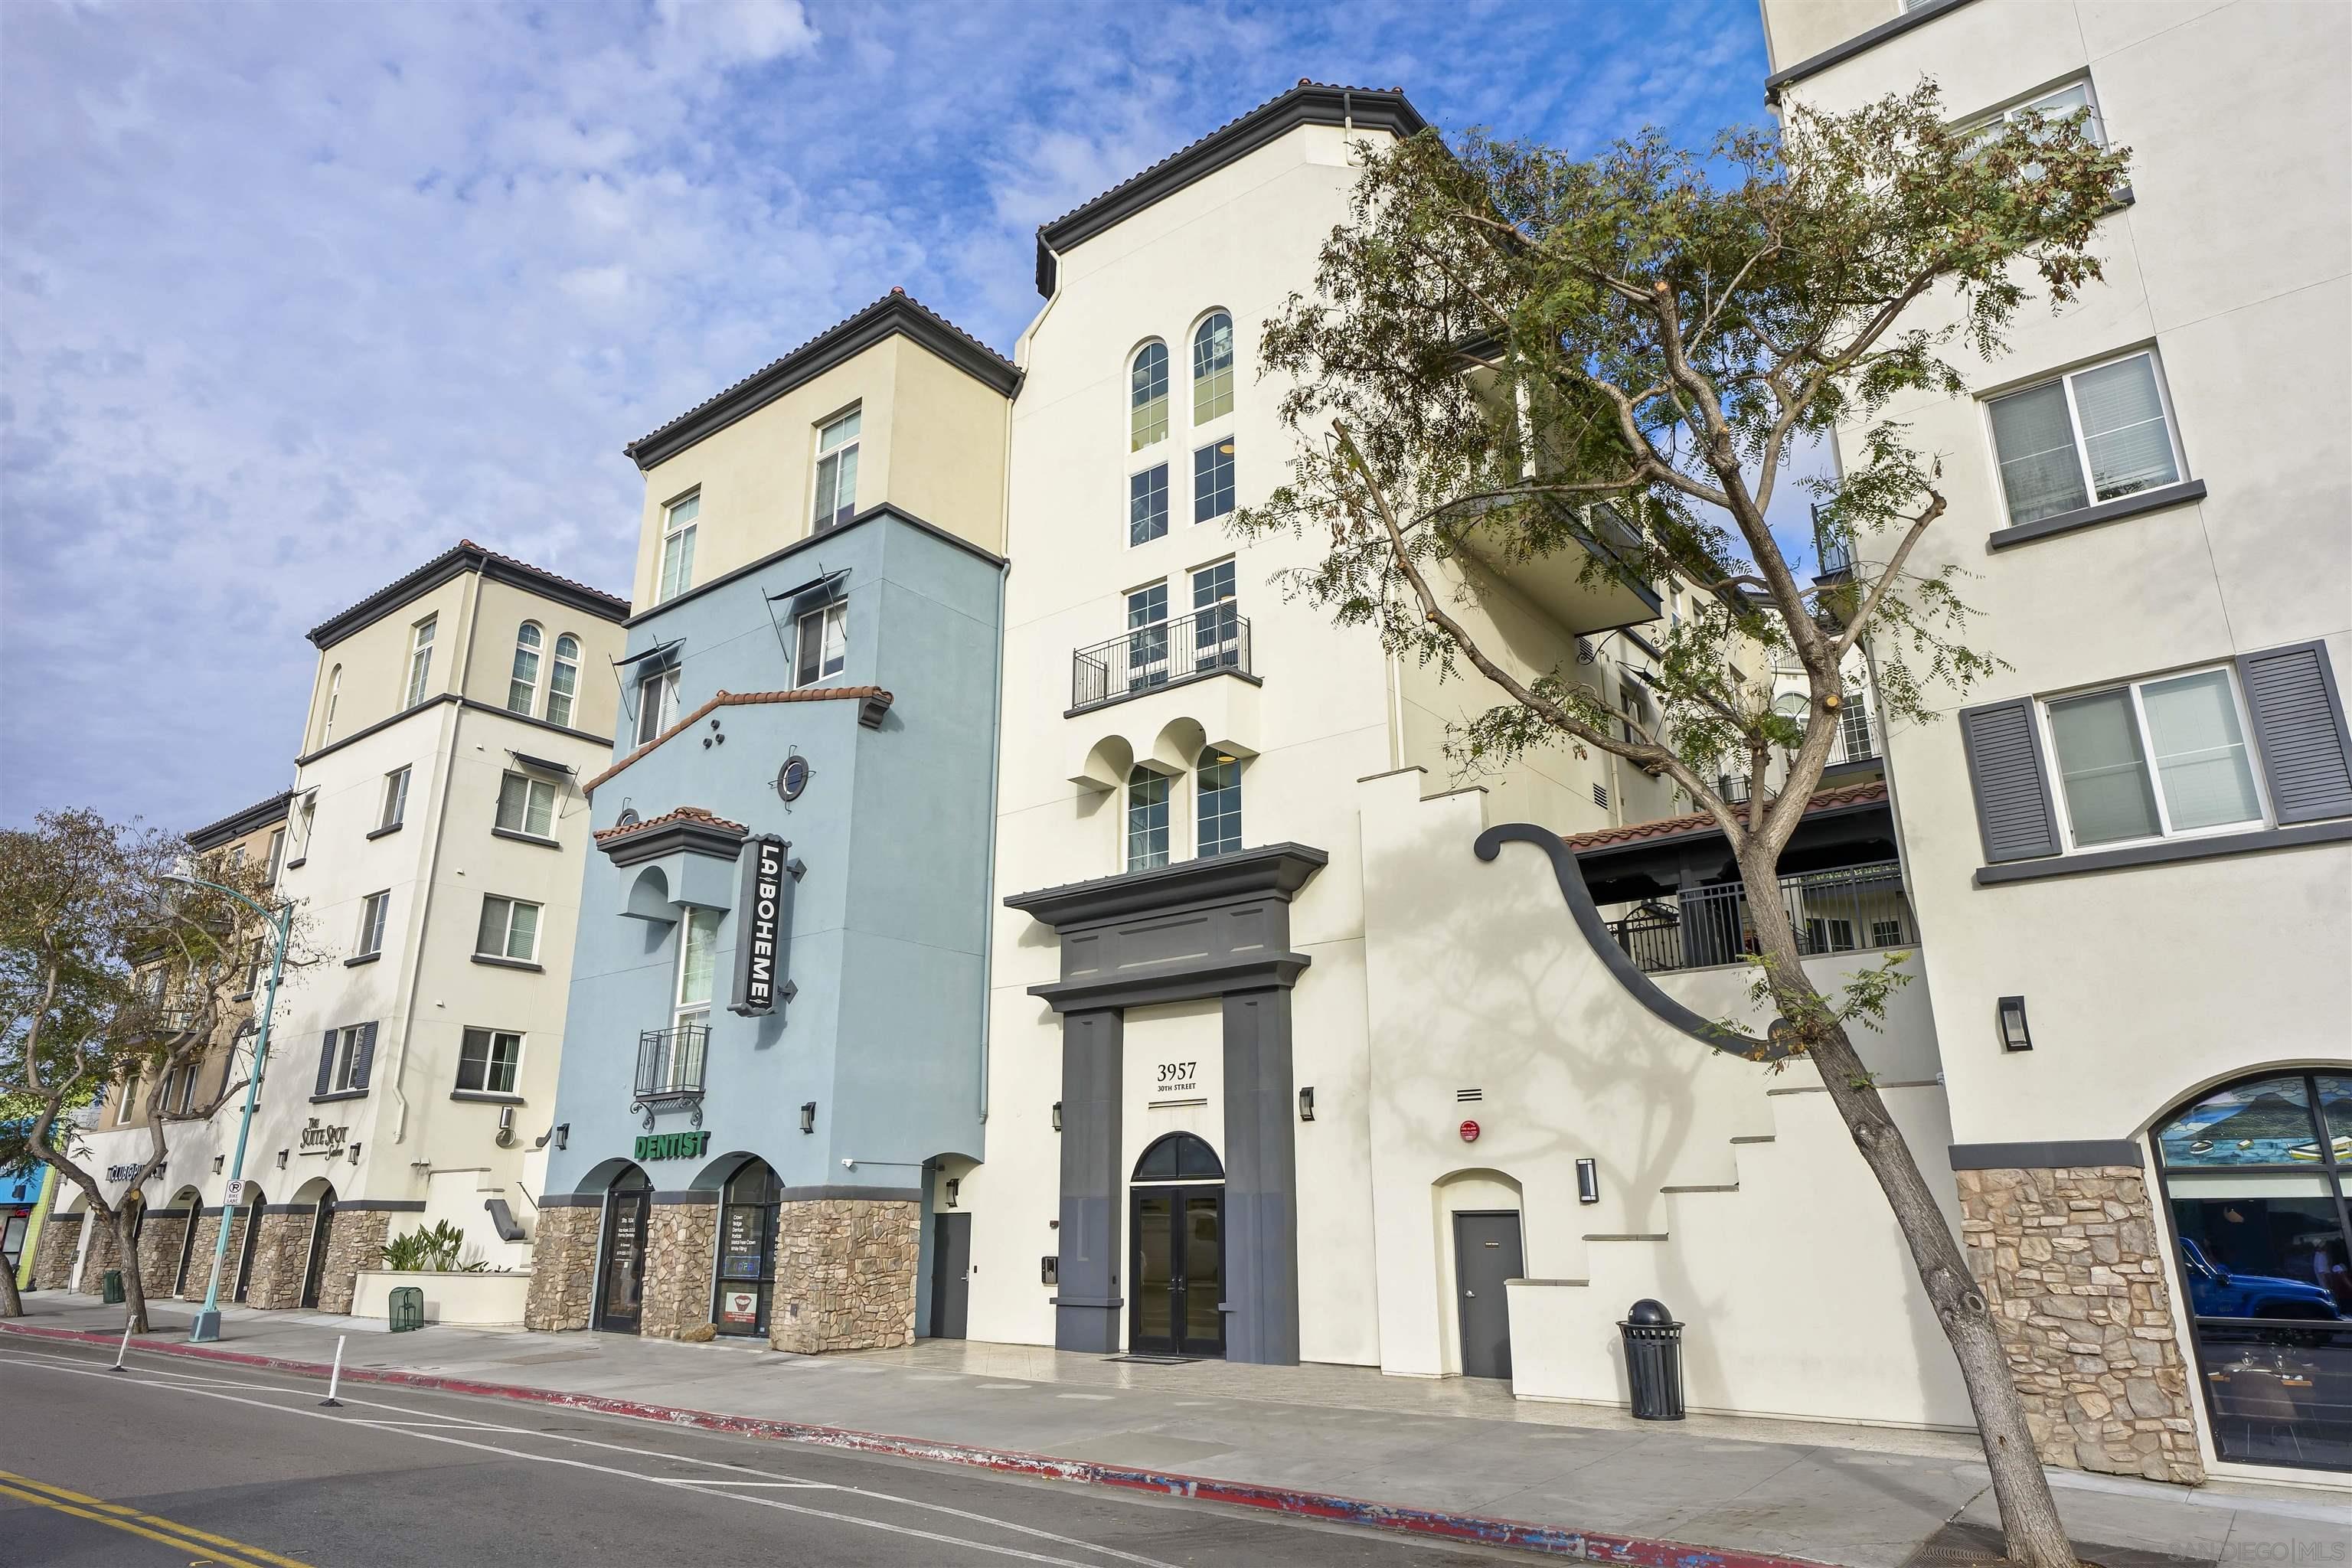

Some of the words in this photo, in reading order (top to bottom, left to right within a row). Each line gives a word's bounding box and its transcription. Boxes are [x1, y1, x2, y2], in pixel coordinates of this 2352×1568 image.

[761, 844, 779, 874] LA
[751, 885, 776, 998] BOHEME
[1157, 1061, 1197, 1082] 3957
[1174, 1083, 1197, 1091] STREET
[300, 1127, 325, 1148] SUITE
[325, 1124, 349, 1146] SPOT
[634, 1130, 707, 1159] DENTIST
